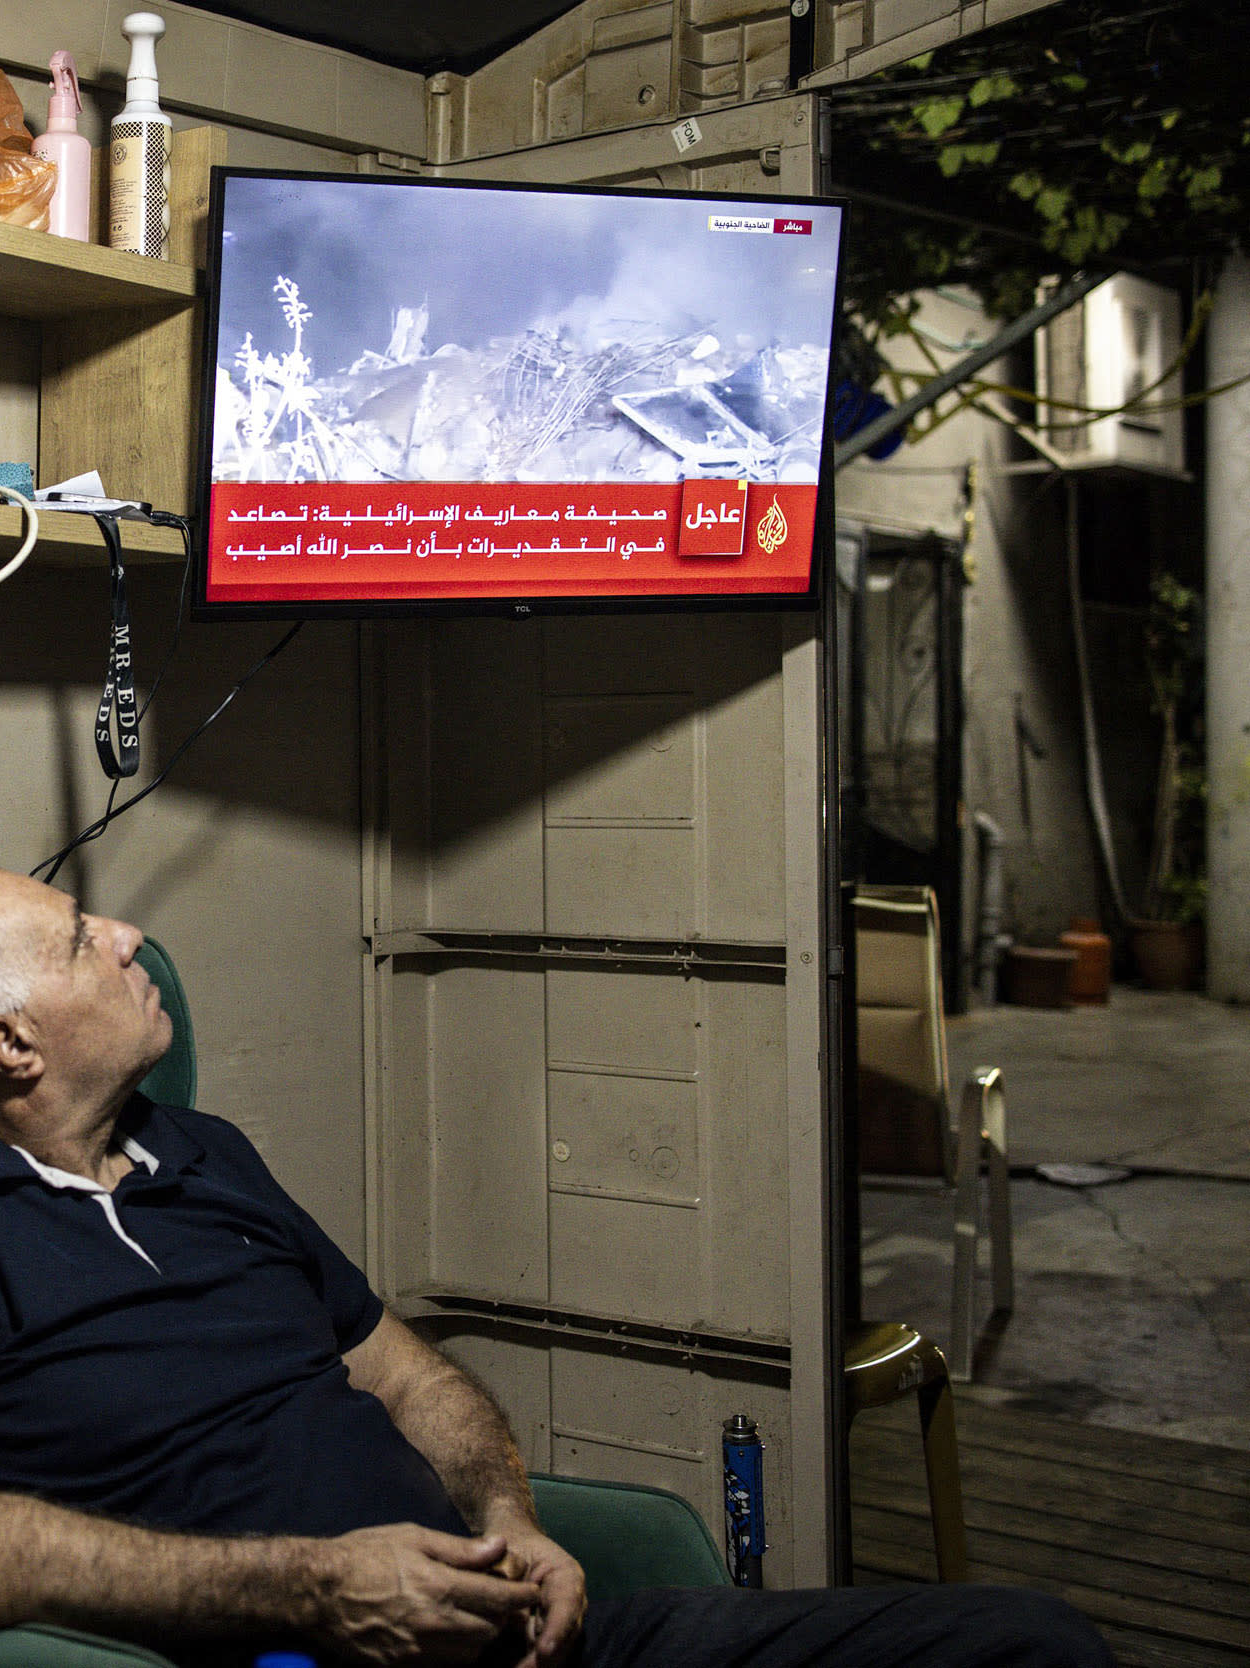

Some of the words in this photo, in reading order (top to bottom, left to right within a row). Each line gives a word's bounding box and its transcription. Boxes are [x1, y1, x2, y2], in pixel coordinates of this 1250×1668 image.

[714, 219, 742, 230] الجنوبية
[744, 221, 770, 231] الضاحية
[782, 221, 803, 233] مباشر
[227, 504, 308, 522] تصاعد
[312, 502, 460, 530] الإسرائيلية:
[464, 504, 560, 526] معاريف
[564, 504, 667, 526] صحيفة
[685, 502, 741, 530] عاجل
[225, 534, 302, 561] أصيب
[306, 533, 338, 555] الله
[340, 538, 412, 560] نصر
[415, 530, 463, 559] بأن
[467, 536, 616, 559] التقديرات
[619, 536, 665, 561] في
[515, 605, 531, 613] TCL
